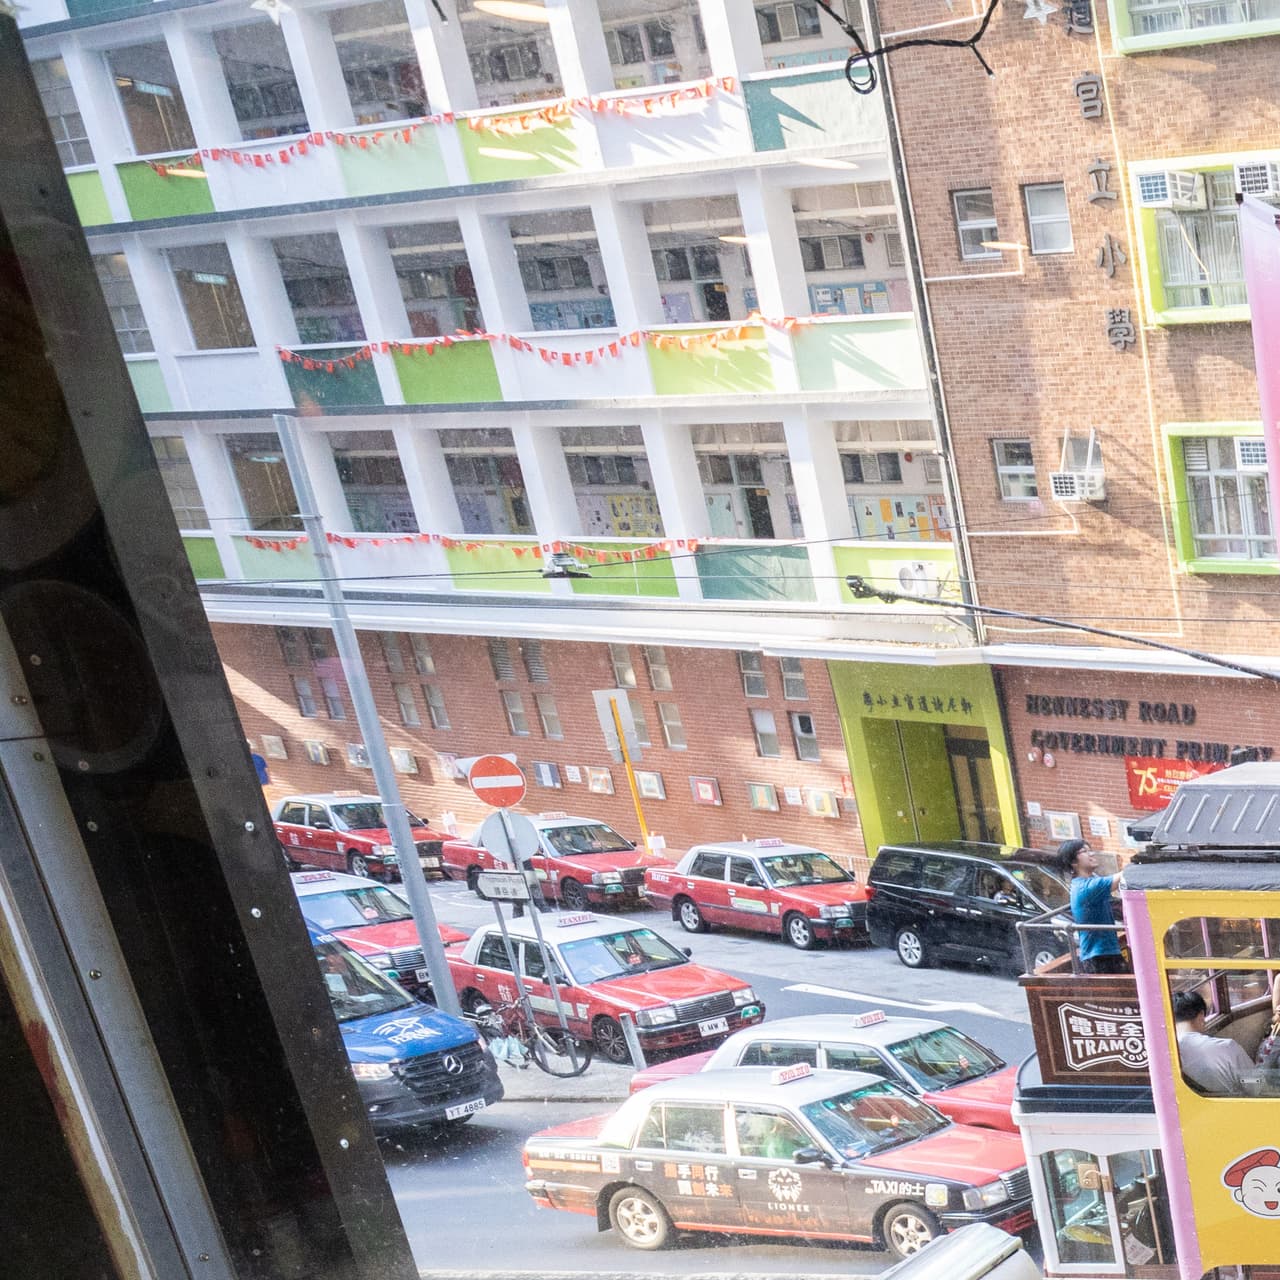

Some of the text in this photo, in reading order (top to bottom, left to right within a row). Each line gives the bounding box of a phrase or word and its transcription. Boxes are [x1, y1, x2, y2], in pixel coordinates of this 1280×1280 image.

[1026, 694, 1197, 726] HENNESSY ROAD
[1031, 729, 1168, 758] GOVERNMENT
[1133, 767, 1157, 796] 75
